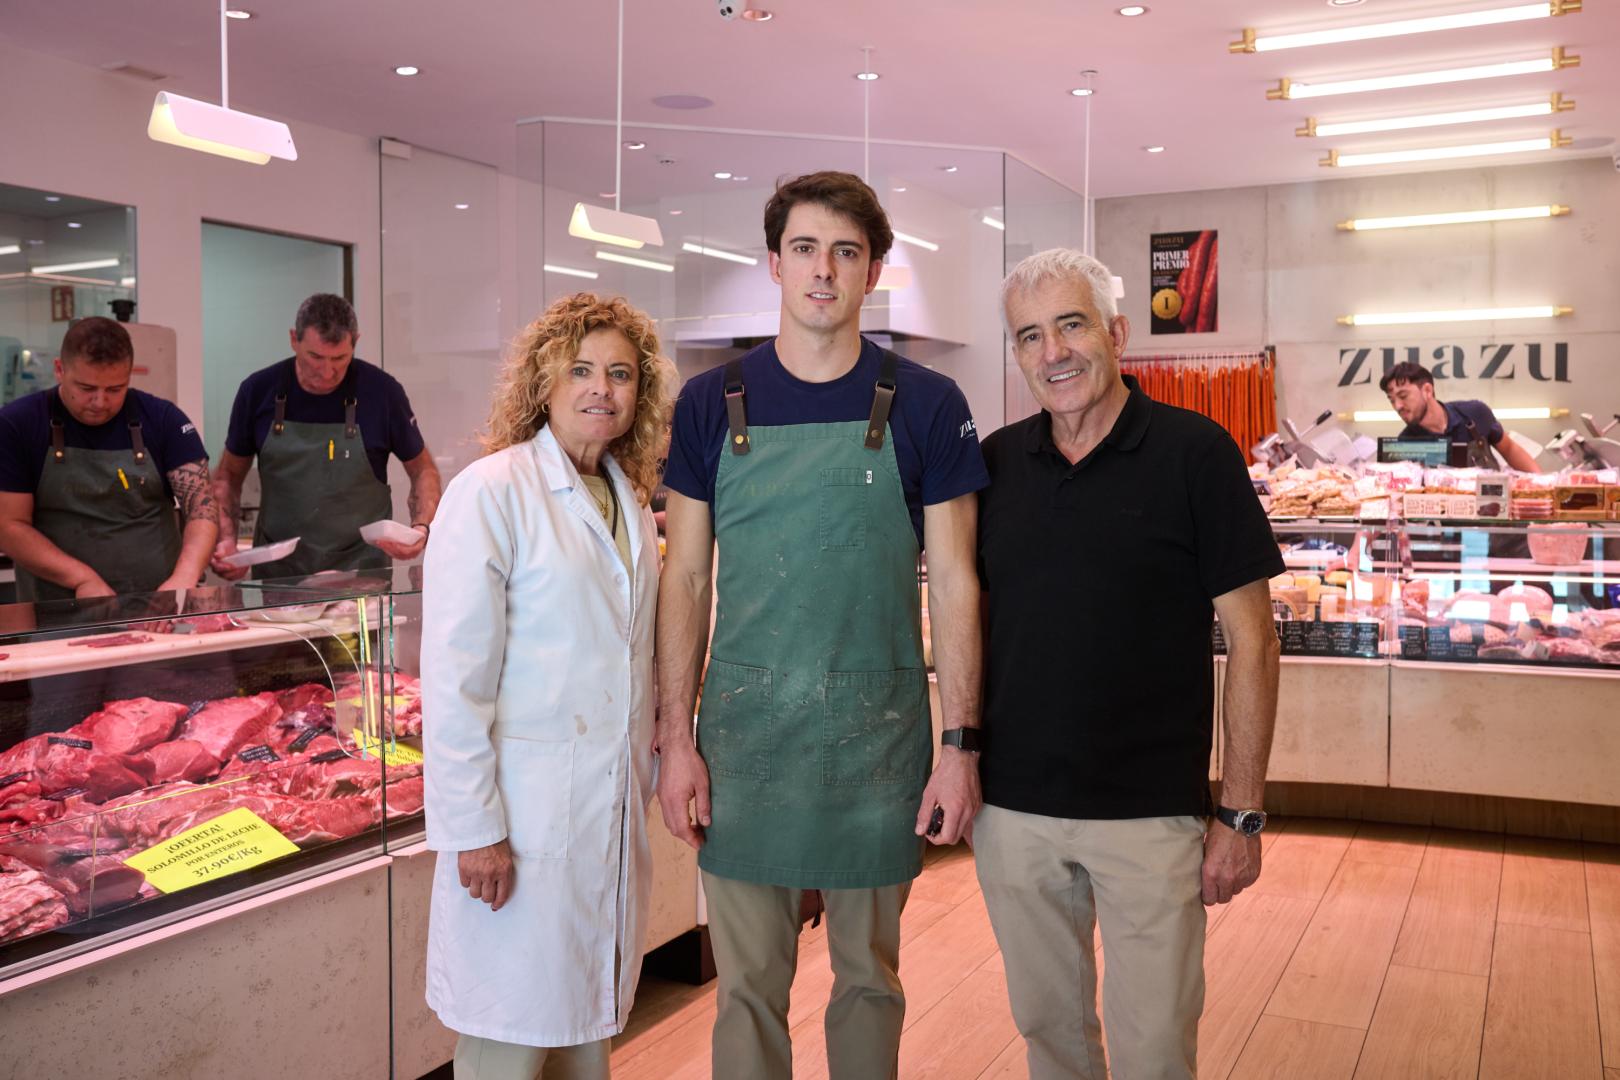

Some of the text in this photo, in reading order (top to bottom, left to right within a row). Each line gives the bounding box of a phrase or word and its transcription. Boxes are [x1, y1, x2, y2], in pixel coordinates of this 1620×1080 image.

[1153, 250, 1189, 261] PRIMER
[1153, 260, 1190, 270] PREMIO
[147, 822, 261, 873] SOLOMILLO DE LECHE
[185, 839, 245, 867] POR ENTEROS
